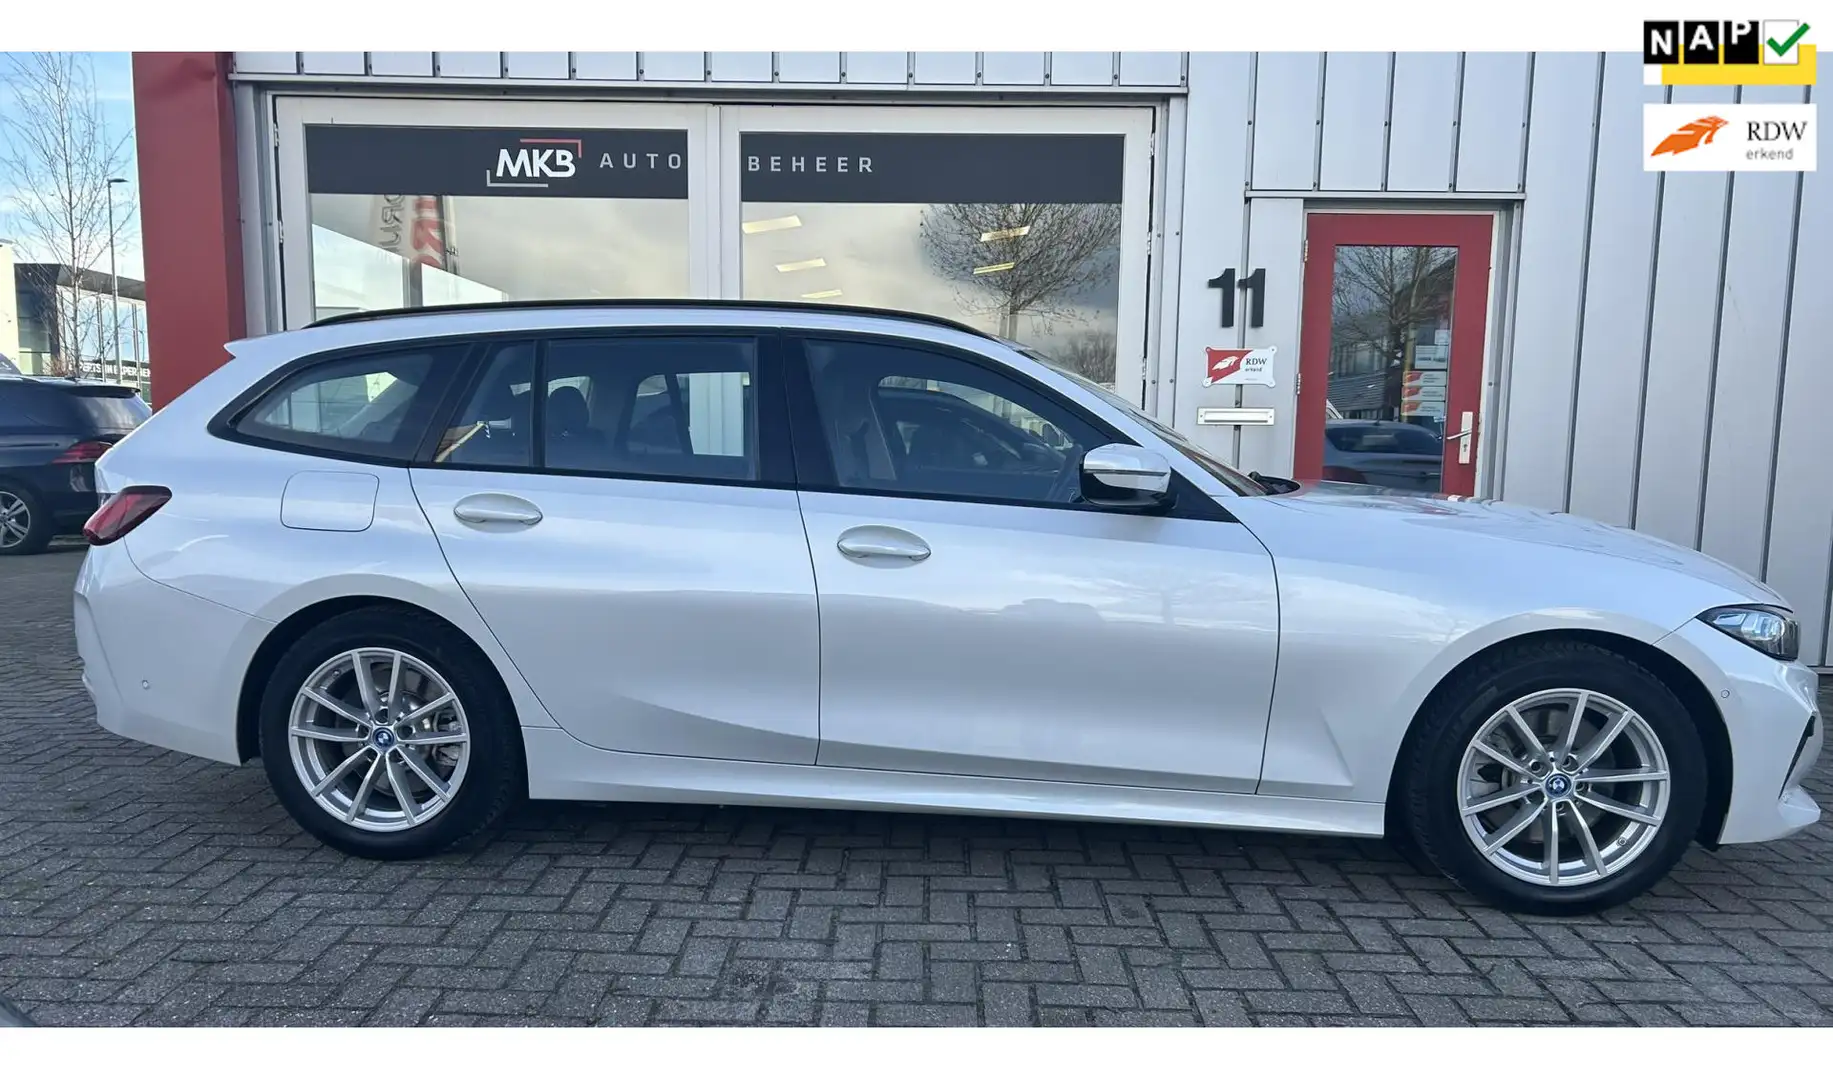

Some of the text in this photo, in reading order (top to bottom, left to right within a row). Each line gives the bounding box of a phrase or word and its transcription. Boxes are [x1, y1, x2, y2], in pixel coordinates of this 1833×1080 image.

[496, 149, 873, 177] MKB AUTO BEHEER
[1207, 268, 1266, 328] 11
[68, 362, 101, 373] EPERTS
[1245, 358, 1267, 366] RDW
